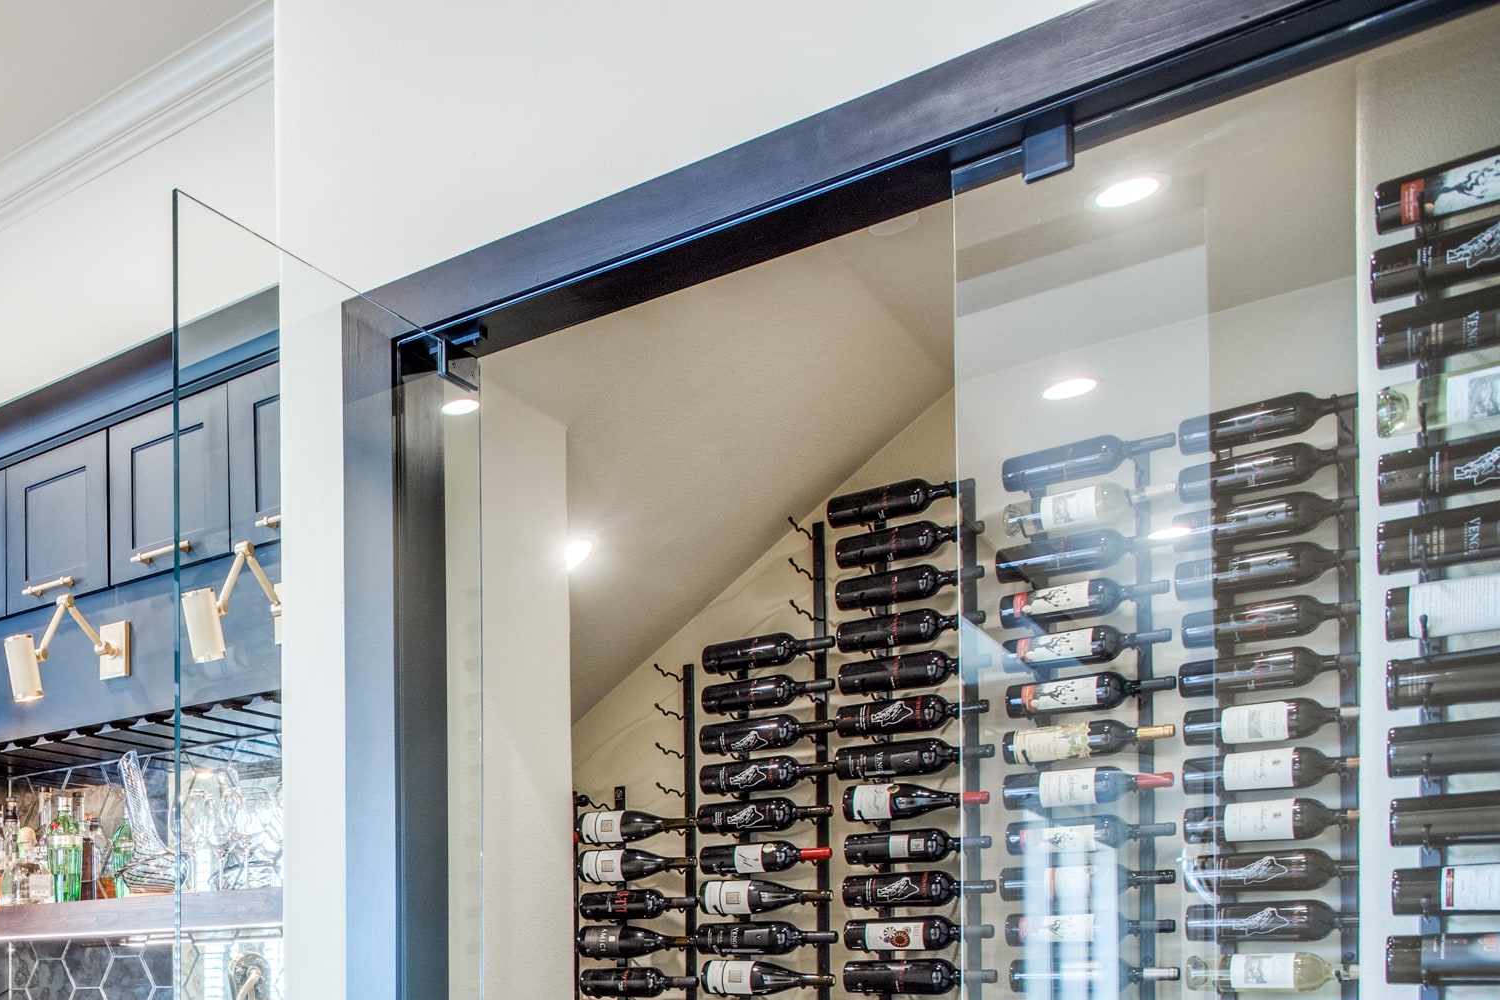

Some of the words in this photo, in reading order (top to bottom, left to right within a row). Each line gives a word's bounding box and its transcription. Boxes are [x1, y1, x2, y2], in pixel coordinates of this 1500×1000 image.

[1468, 517, 1481, 555] VENGE
[876, 752, 884, 772] VENG
[615, 890, 629, 914] UTT
[599, 928, 608, 952] AMICI
